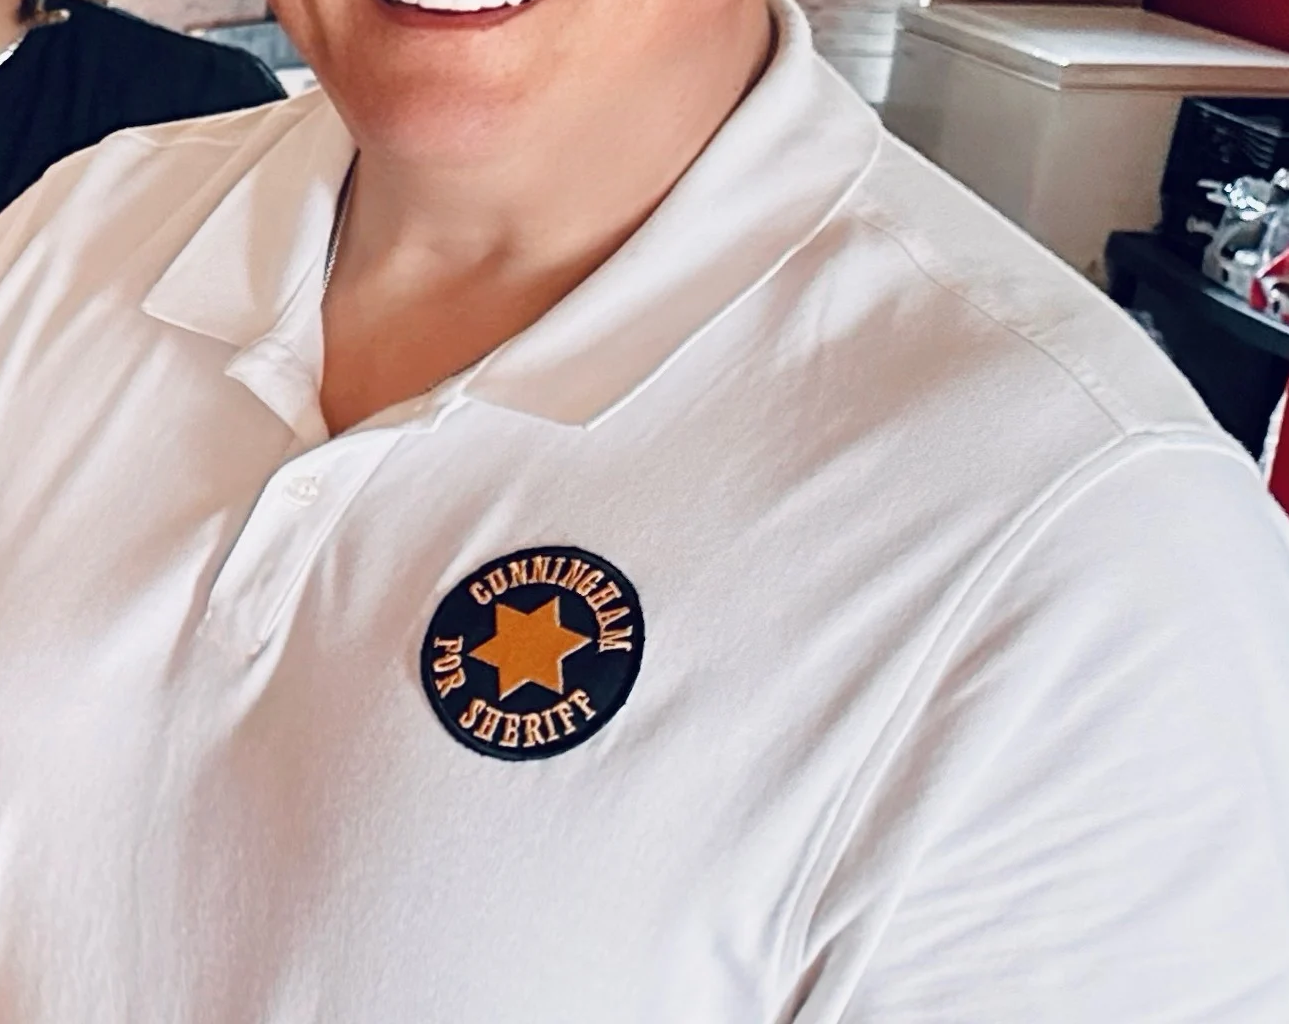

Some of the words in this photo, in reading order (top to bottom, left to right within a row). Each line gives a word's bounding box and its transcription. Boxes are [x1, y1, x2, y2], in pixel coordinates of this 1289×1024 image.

[469, 554, 634, 653] CUNNINGHAM
[433, 635, 467, 699] FOR
[458, 688, 597, 748] SHERIFF
